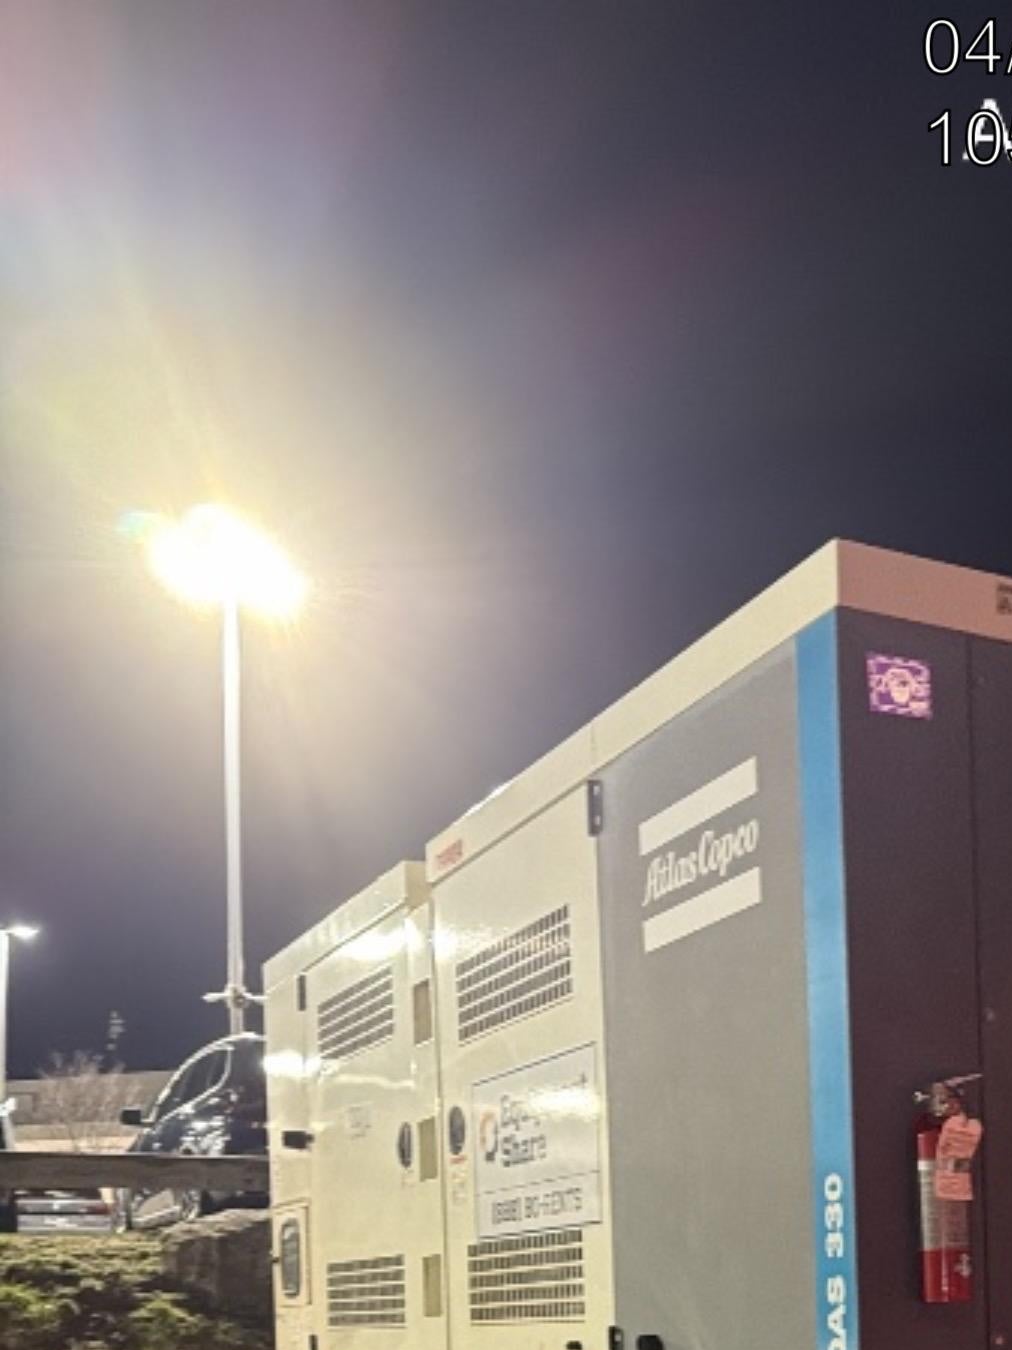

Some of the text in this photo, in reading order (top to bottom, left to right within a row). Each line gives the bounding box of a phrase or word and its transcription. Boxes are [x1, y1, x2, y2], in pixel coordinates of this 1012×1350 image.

[641, 819, 759, 907] Atlas Copco
[823, 1172, 844, 1259] 330
